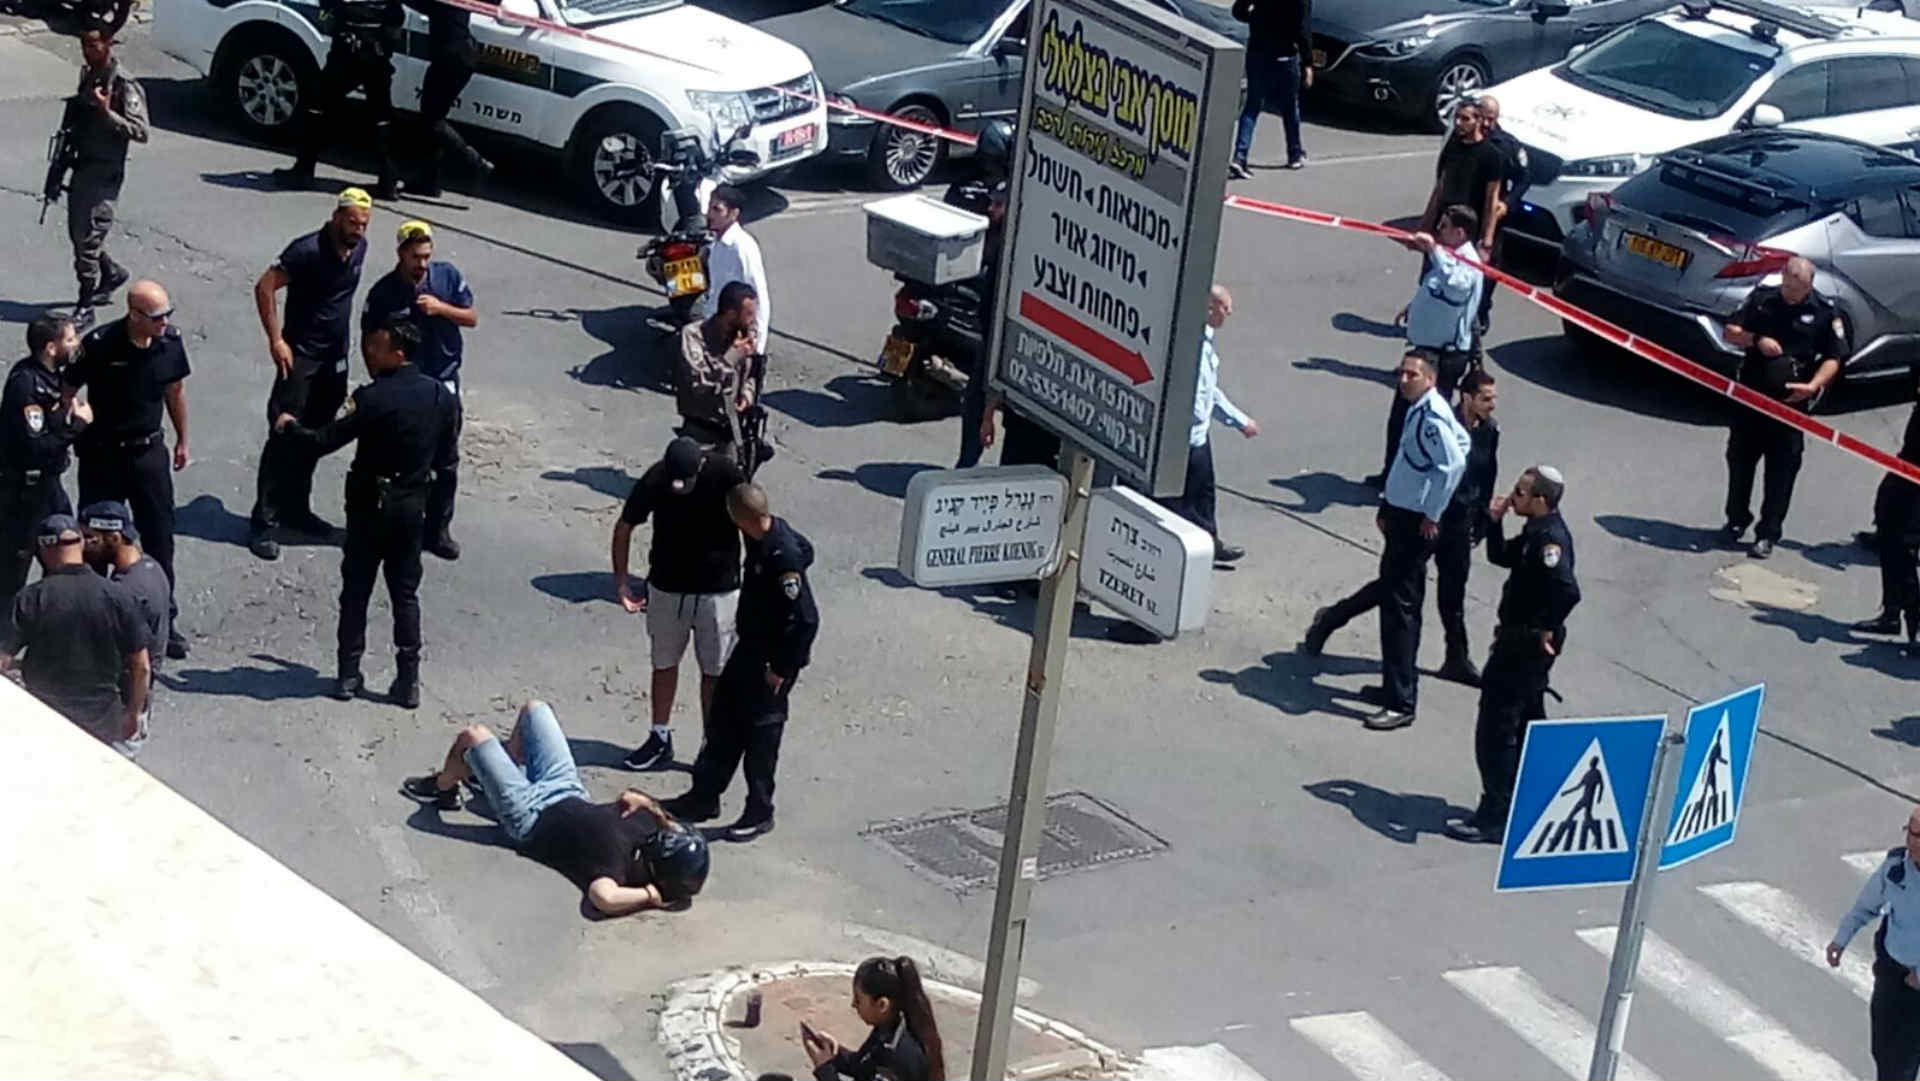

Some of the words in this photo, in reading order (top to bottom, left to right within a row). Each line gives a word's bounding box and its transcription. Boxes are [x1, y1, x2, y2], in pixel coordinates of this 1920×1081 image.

[472, 101, 522, 124] משמר
[1111, 57, 1151, 135] אבי
[1149, 75, 1198, 164] מוסך
[1027, 138, 1083, 202] חשמל
[1051, 211, 1088, 258] אויר
[1097, 184, 1171, 249] מכונאות
[1033, 254, 1077, 304] וצבע
[1090, 233, 1137, 283] מיזוג
[1078, 281, 1140, 338] פחחות
[1116, 390, 1146, 424] צרת
[1127, 428, 1146, 459] רב
[926, 547, 966, 567] GENERAL
[1098, 567, 1145, 607] TZERET
